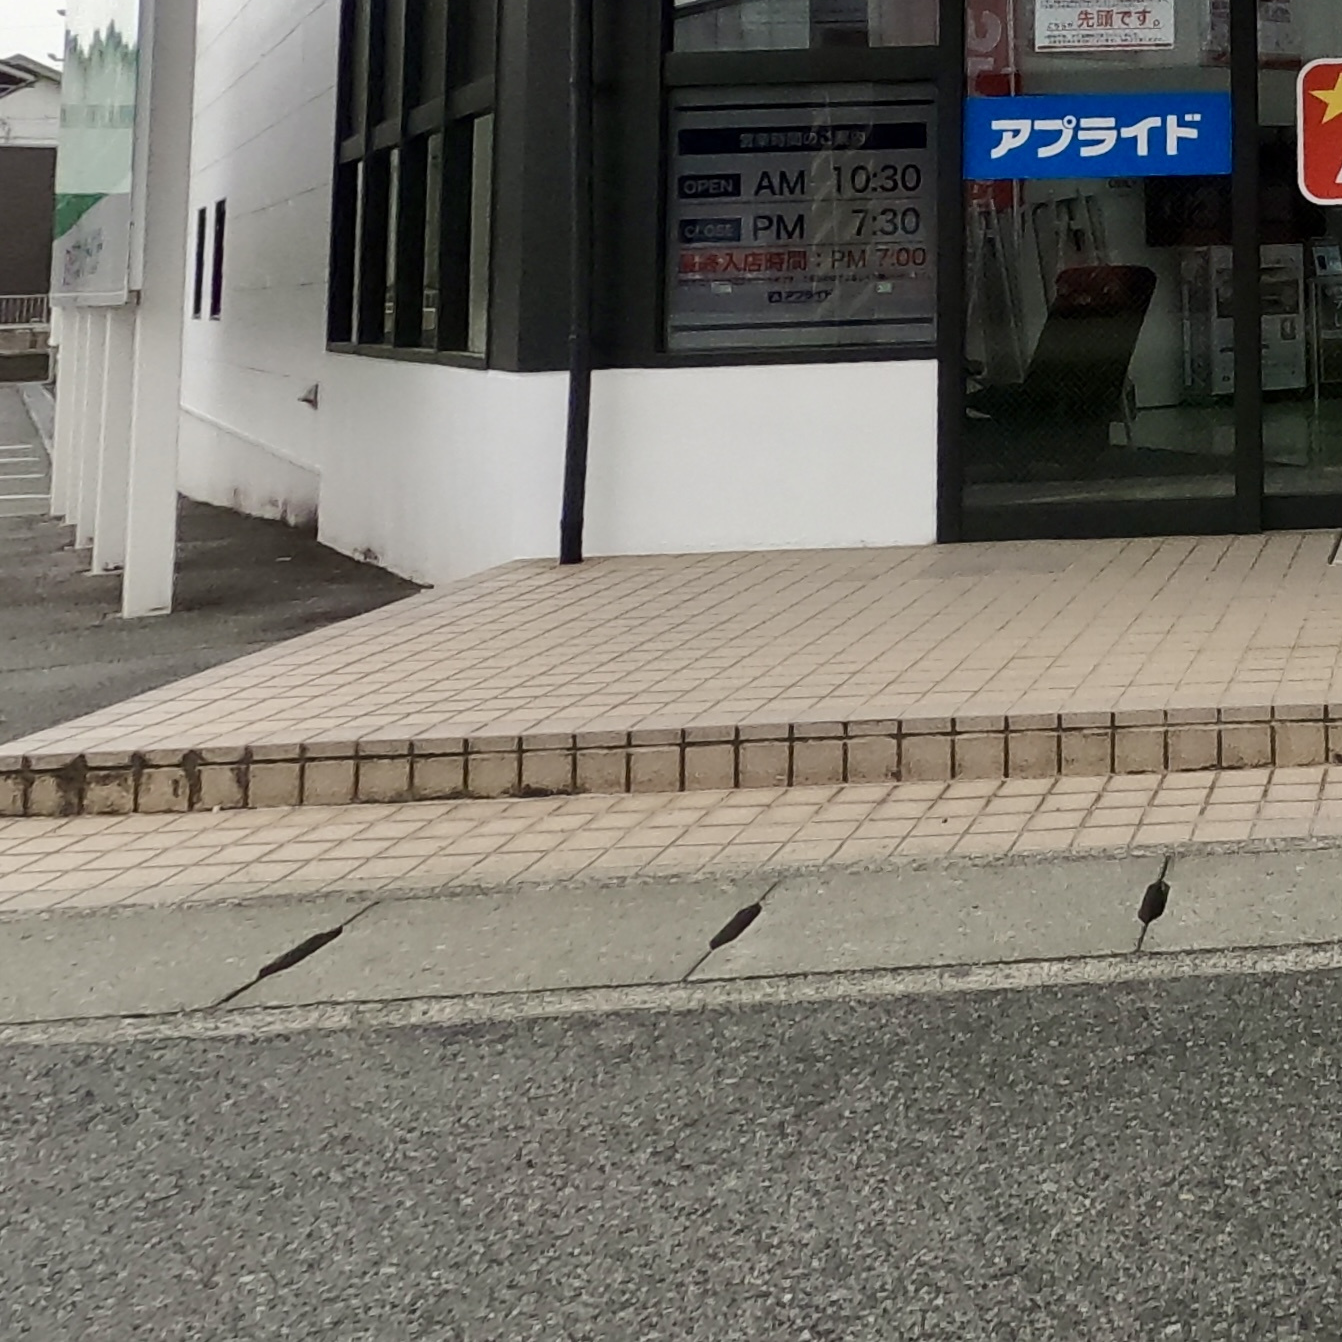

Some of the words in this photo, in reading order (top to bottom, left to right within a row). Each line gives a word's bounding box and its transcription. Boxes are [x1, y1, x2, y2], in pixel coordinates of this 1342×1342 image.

[990, 114, 1201, 158] アプライド
[683, 179, 734, 194] OPEN
[754, 170, 805, 195] AM
[833, 164, 922, 193] 10:30
[684, 223, 734, 238] CLOSE
[753, 215, 804, 240] PM
[852, 208, 920, 236] 7:30
[831, 250, 866, 269] PM
